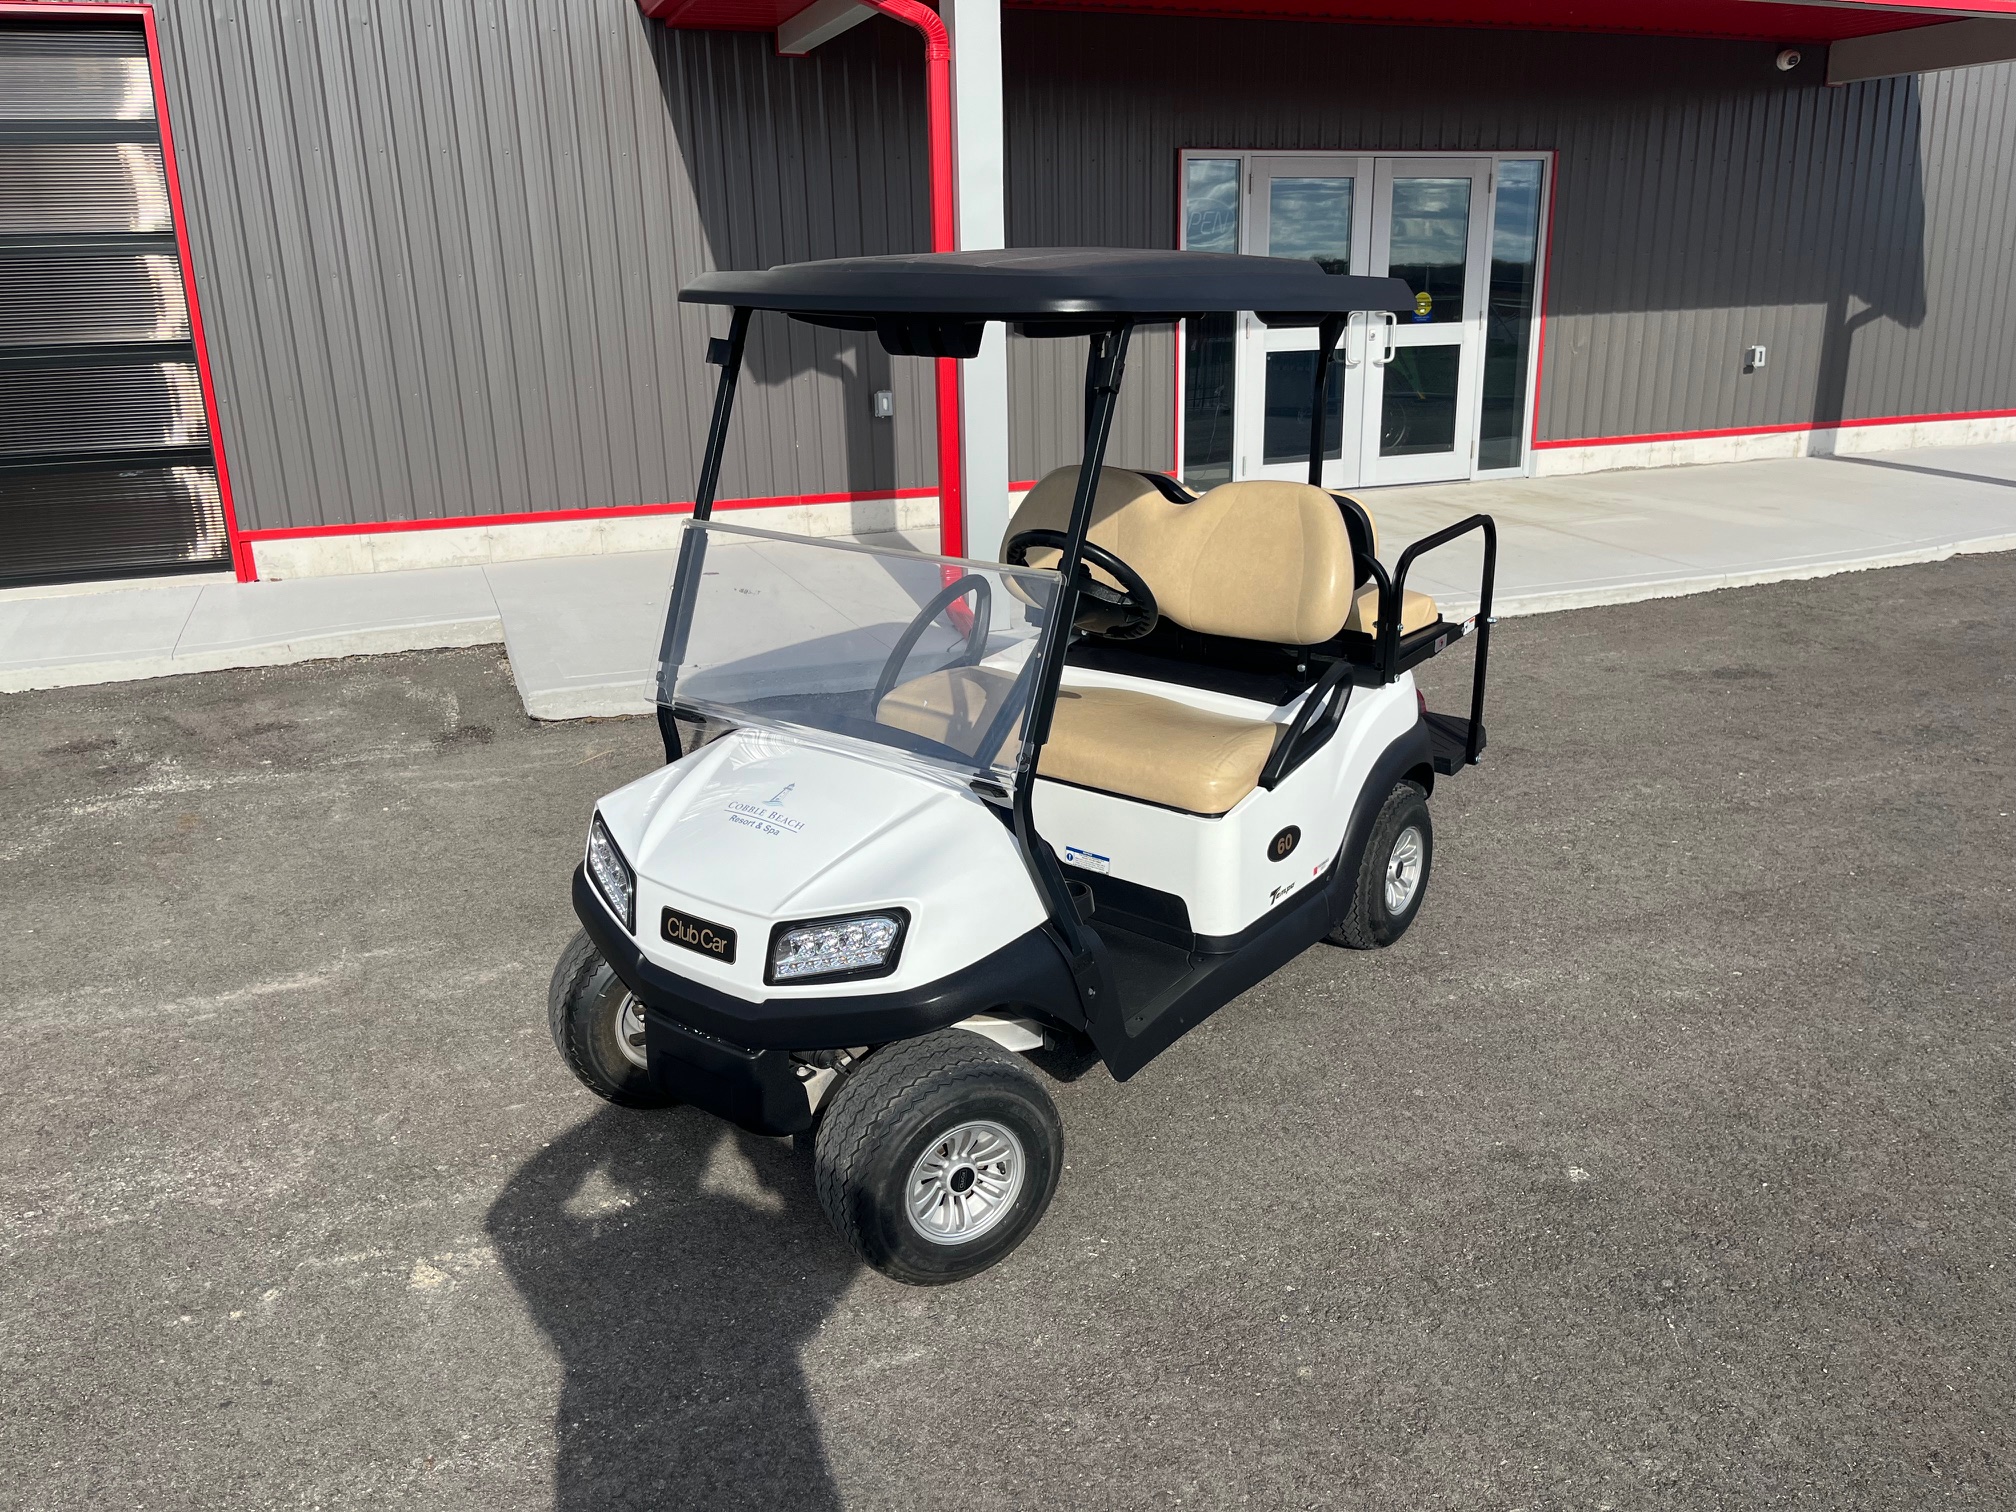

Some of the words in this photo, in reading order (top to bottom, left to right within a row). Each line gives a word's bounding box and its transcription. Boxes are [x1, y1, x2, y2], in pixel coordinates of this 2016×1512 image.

[1188, 211, 1229, 234] PEN
[728, 801, 767, 816] COBBLE
[768, 811, 805, 830] BEACH
[729, 814, 755, 827] Resort
[763, 825, 780, 836] Spa
[1277, 833, 1293, 854] 60
[667, 917, 699, 944] Club
[700, 929, 728, 953] Car
